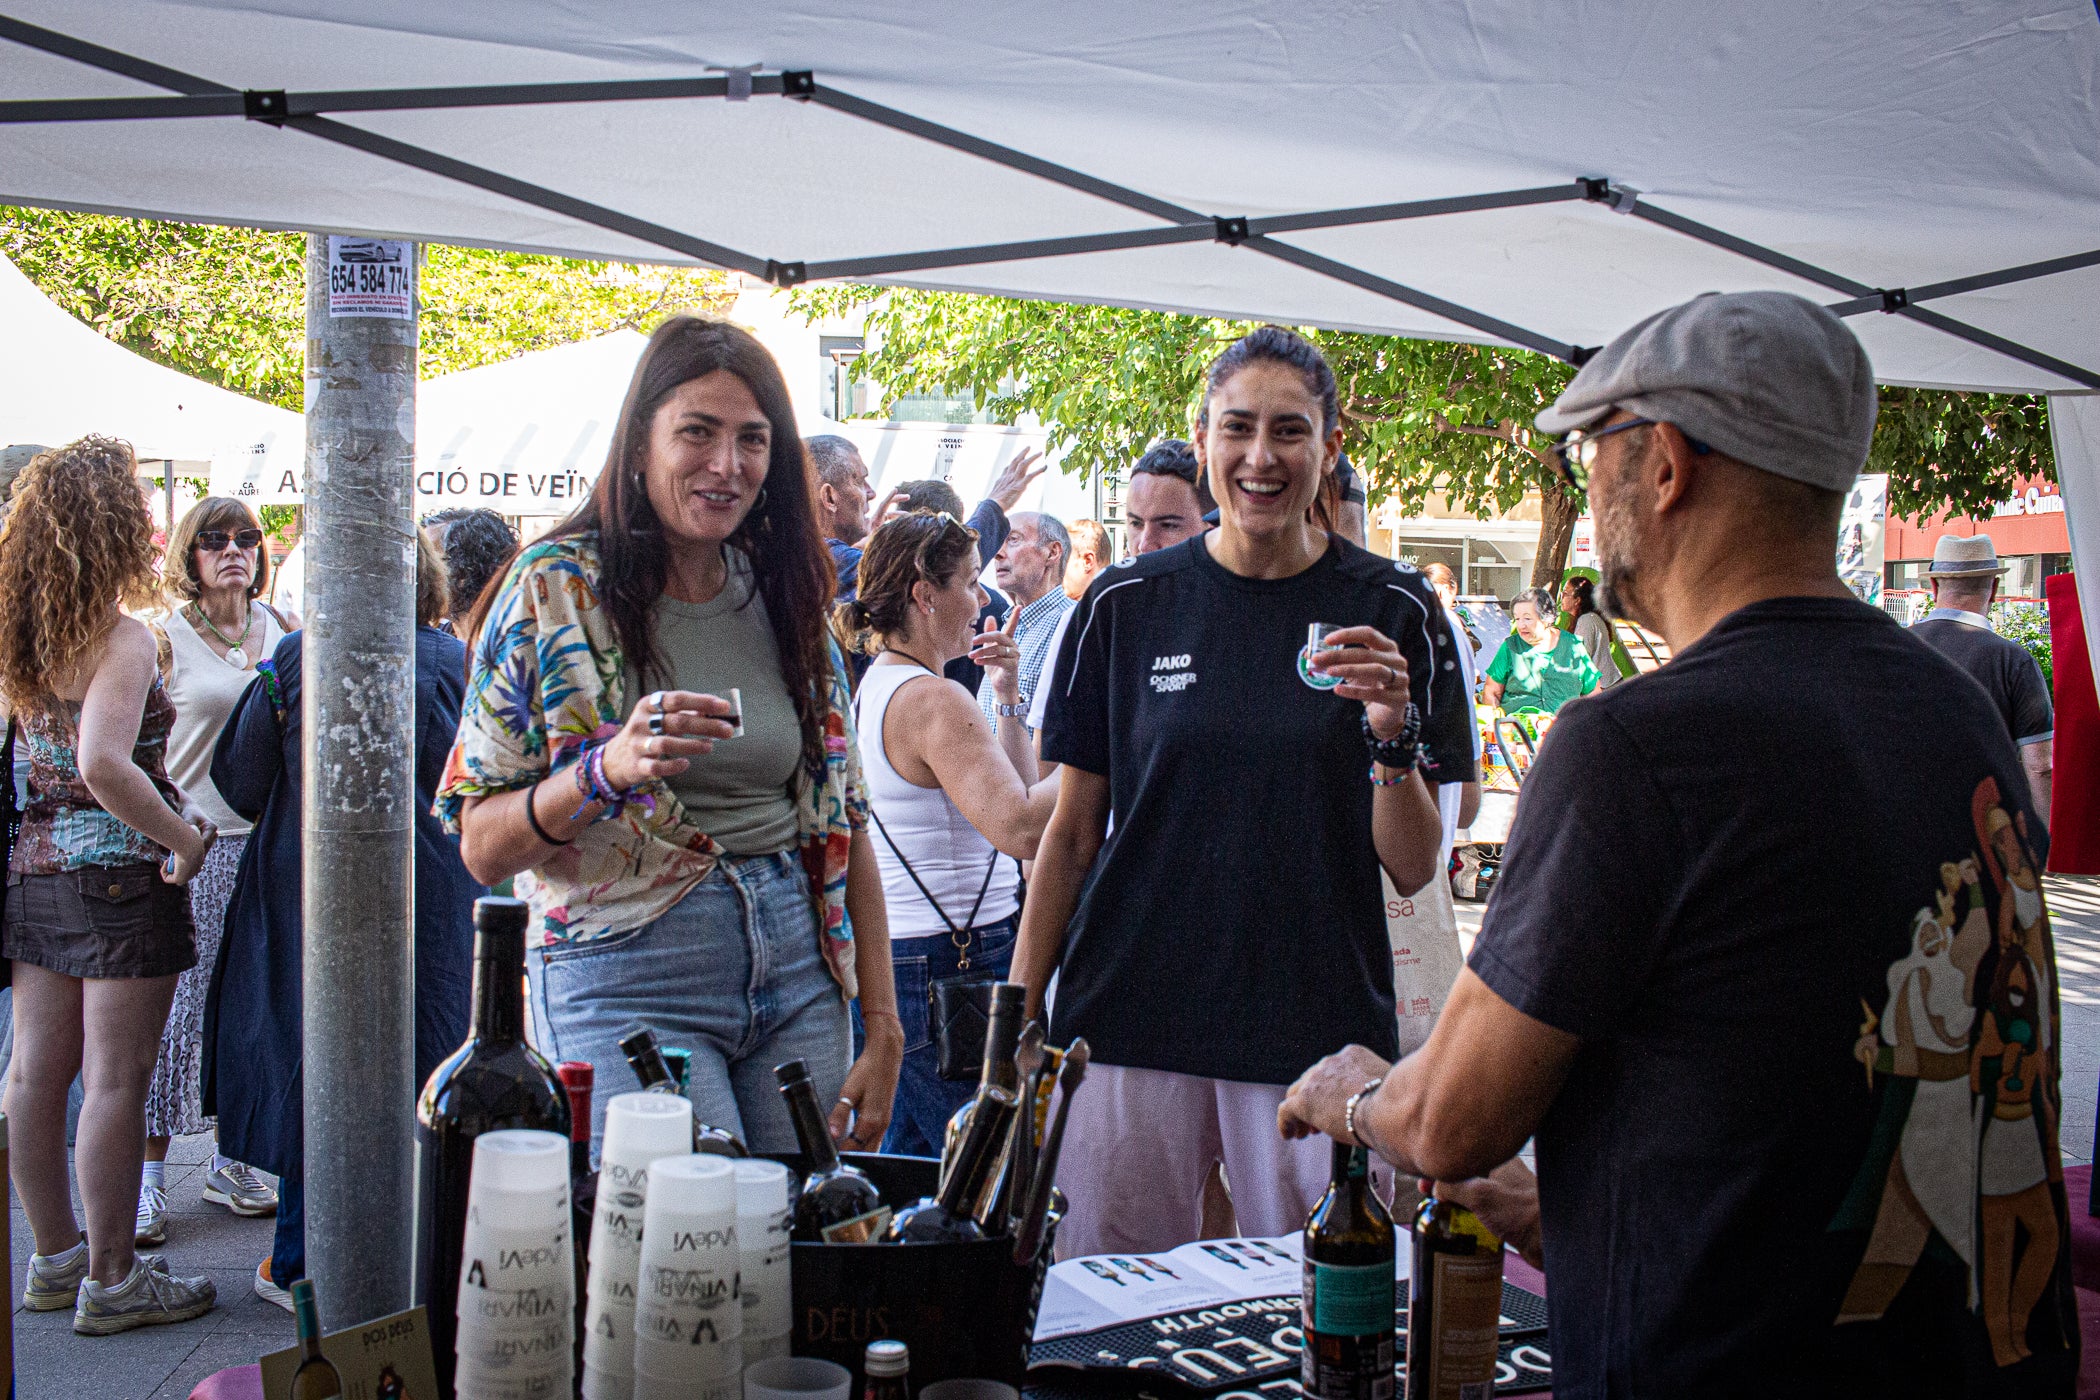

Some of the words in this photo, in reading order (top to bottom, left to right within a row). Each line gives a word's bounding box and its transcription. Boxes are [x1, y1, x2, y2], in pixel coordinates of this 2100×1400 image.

[331, 264, 355, 293] 654
[360, 264, 385, 293] 584
[389, 265, 408, 295] 774
[479, 472, 518, 496] DE
[527, 469, 593, 498] VEÏN
[1151, 653, 1192, 671] JAKO
[1155, 681, 1187, 693] SPORT
[1152, 1297, 1303, 1335] ERMOUTH
[1127, 1326, 1304, 1382] DEU
